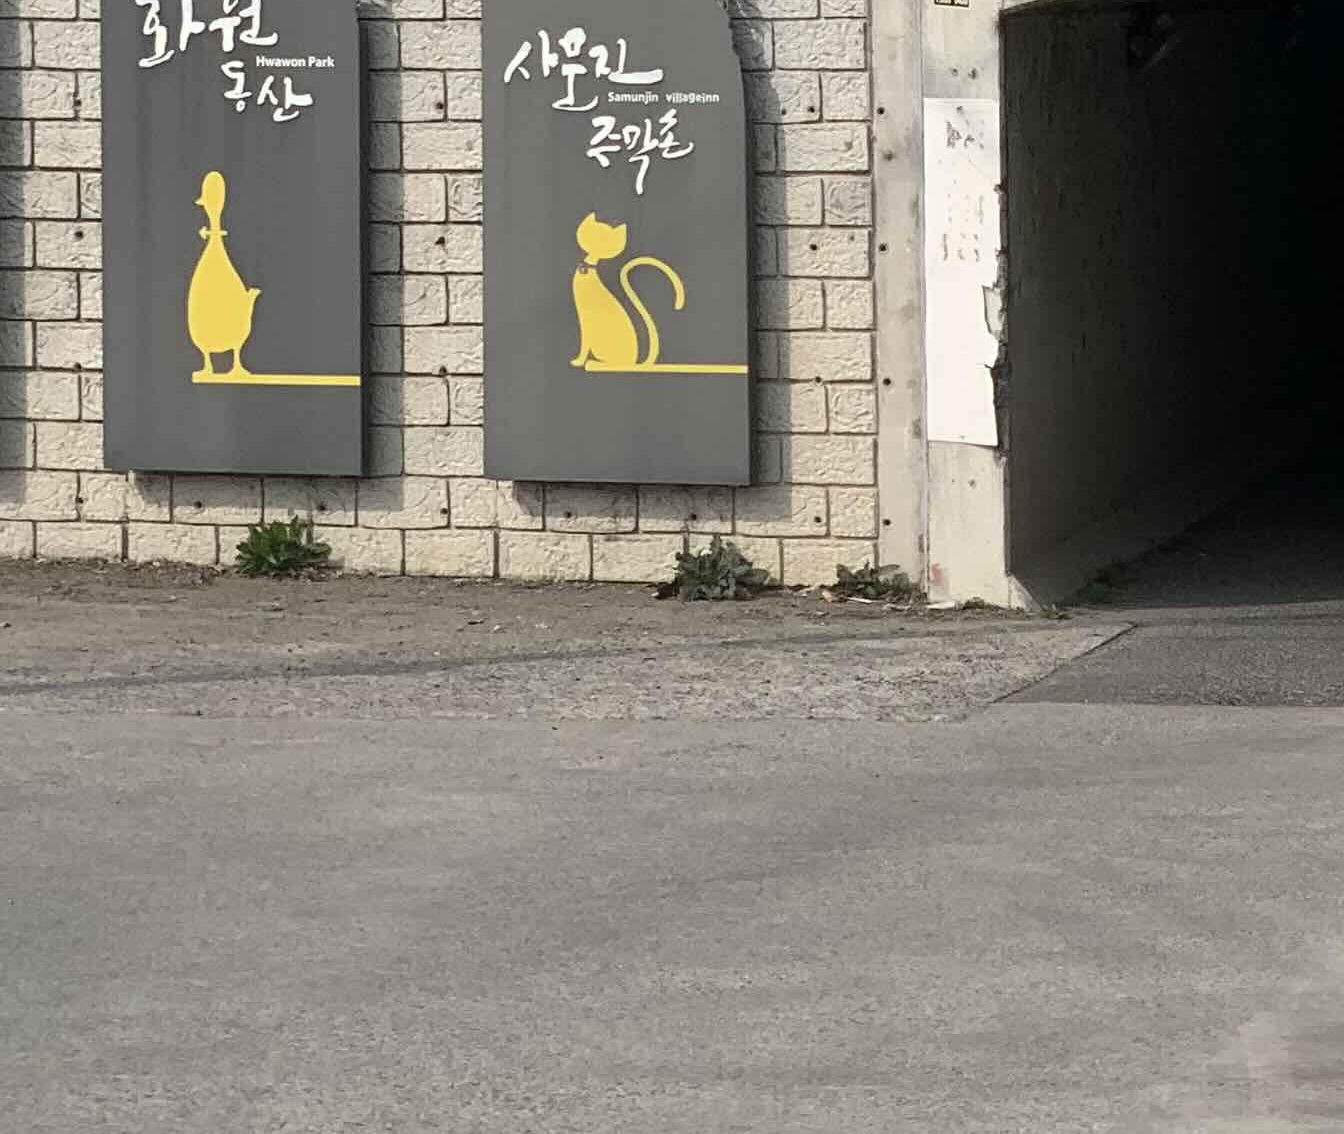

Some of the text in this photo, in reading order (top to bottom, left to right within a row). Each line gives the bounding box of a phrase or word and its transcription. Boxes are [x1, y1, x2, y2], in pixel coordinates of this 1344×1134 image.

[255, 55, 336, 67] Hwawon Park
[220, 60, 314, 122] 동산
[607, 91, 659, 105] Samunjin
[586, 108, 695, 195] 주막촌
